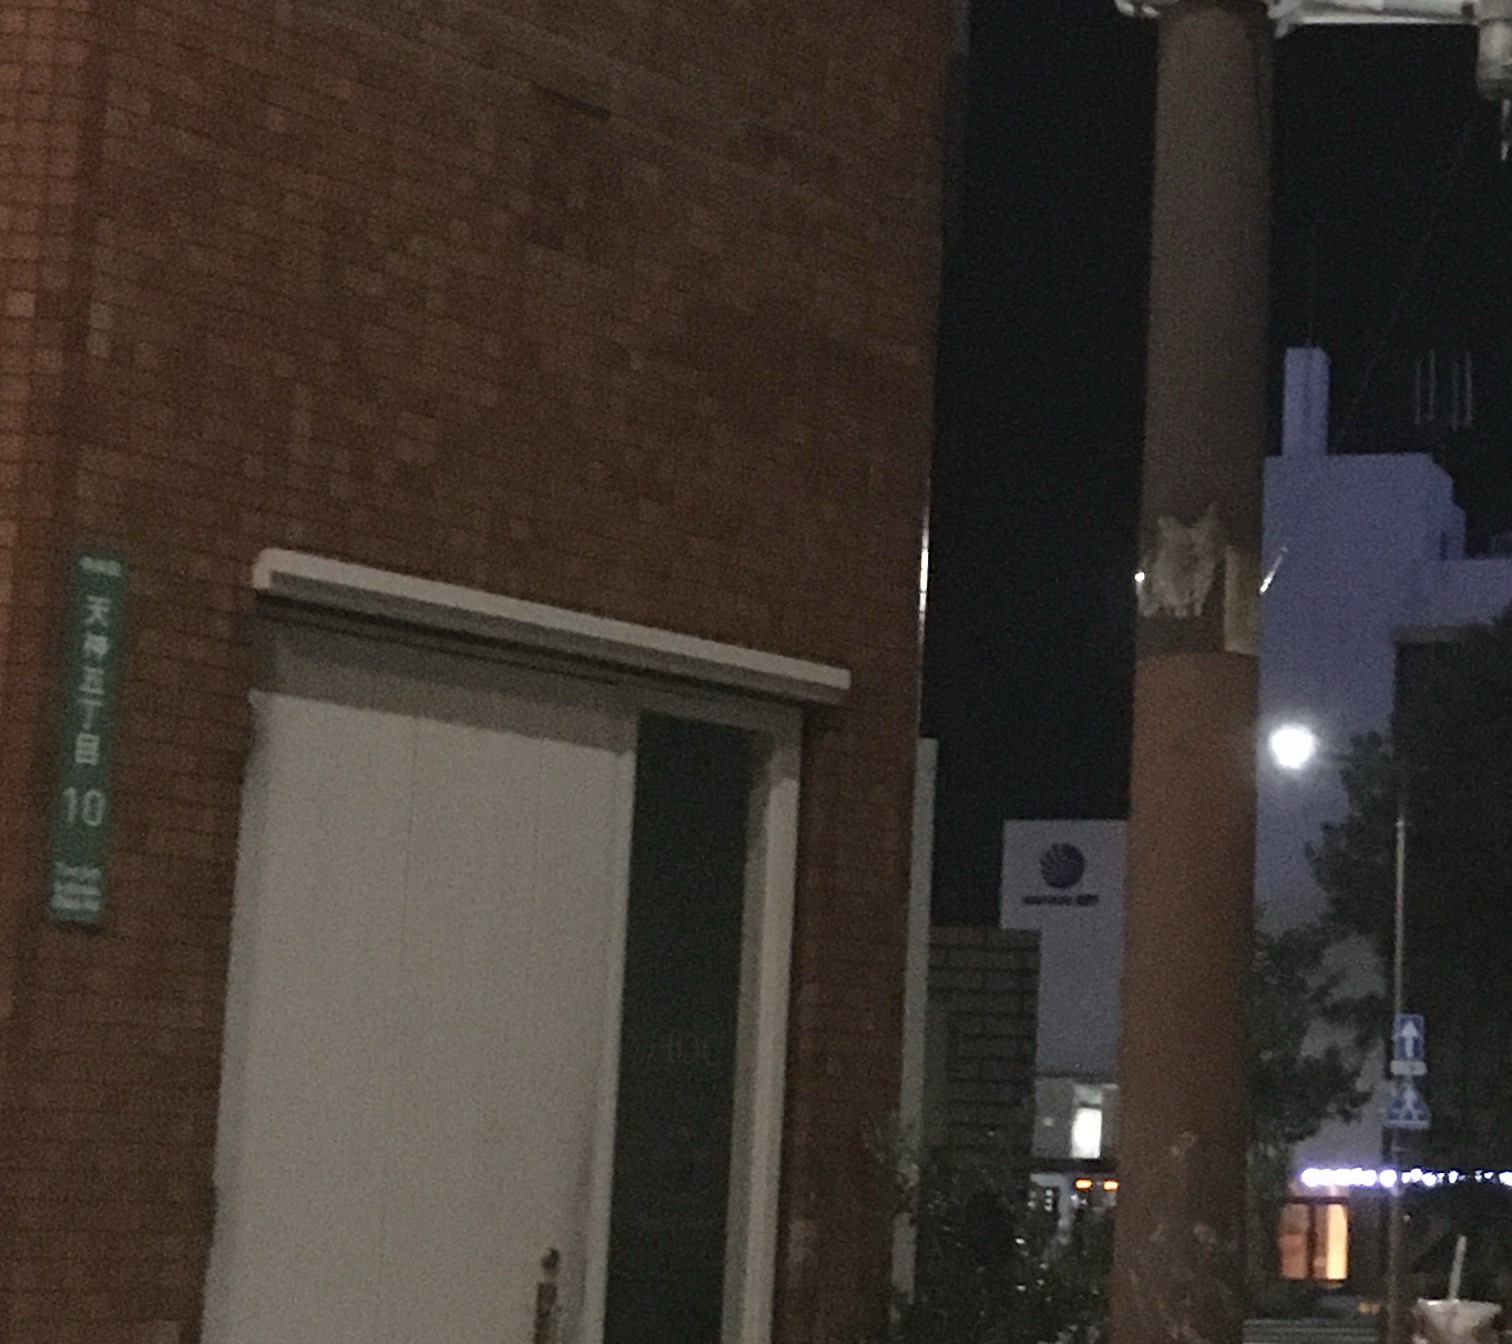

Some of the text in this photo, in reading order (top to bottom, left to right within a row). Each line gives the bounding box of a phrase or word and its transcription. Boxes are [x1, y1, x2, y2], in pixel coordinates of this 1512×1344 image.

[74, 594, 113, 766] 天神五丁目
[62, 786, 106, 828] 10
